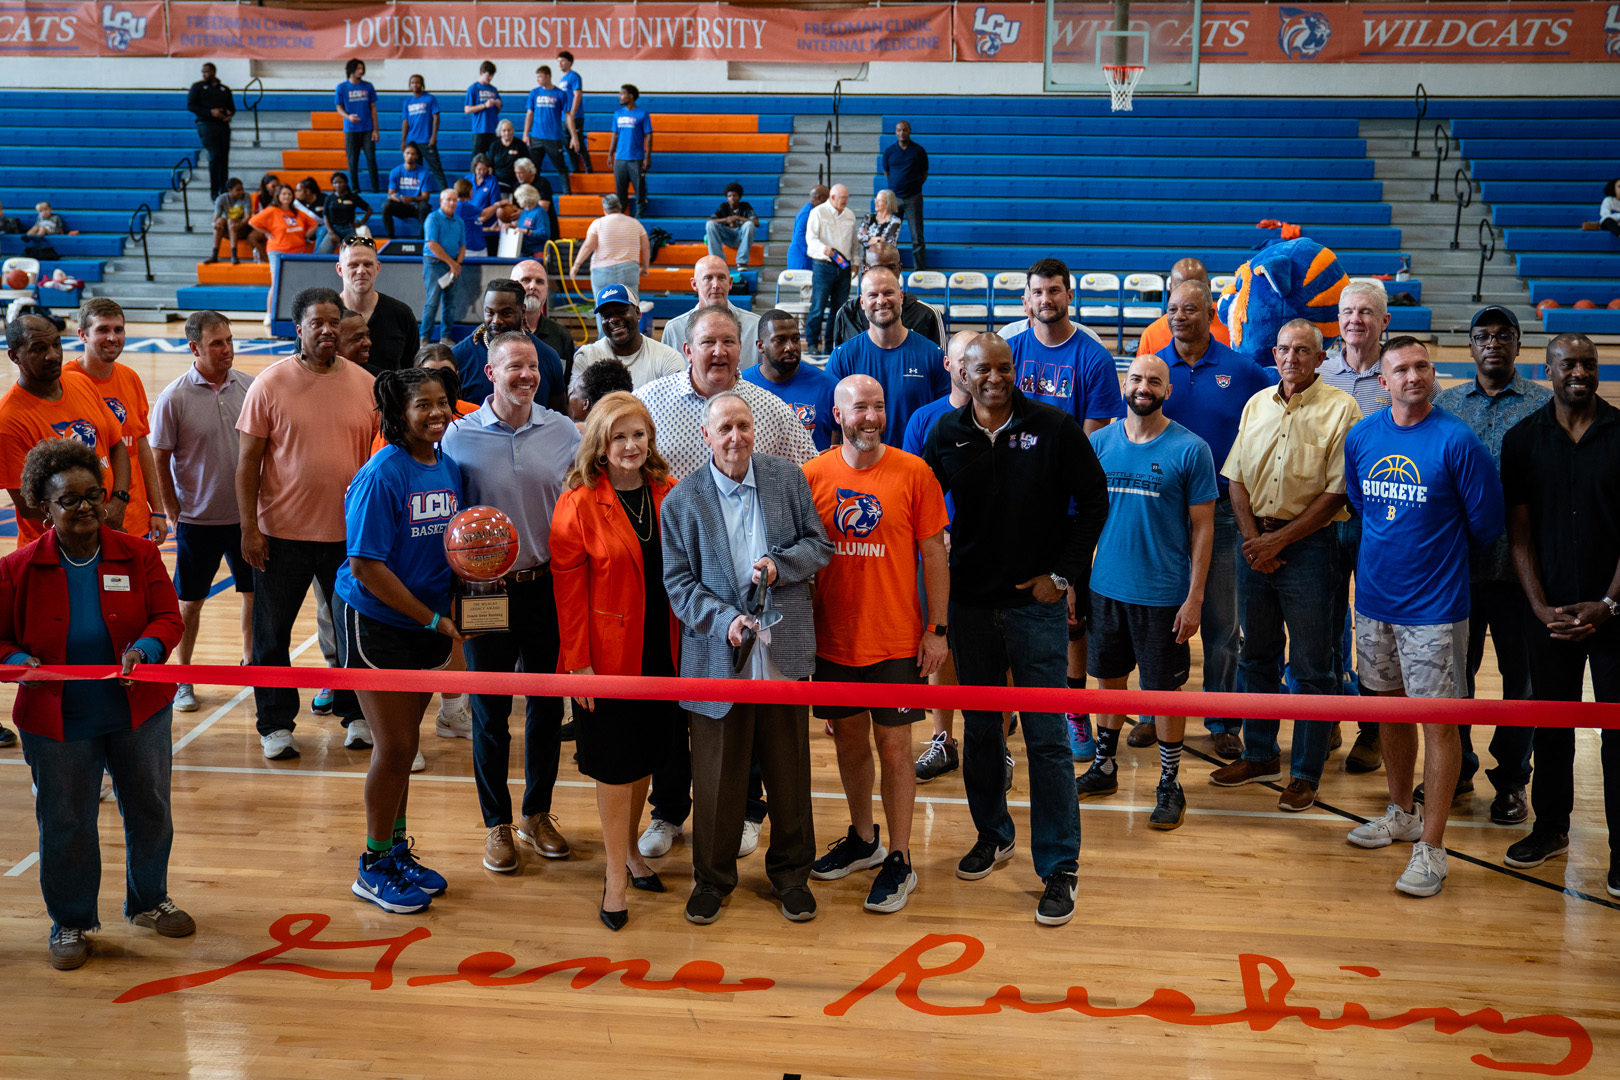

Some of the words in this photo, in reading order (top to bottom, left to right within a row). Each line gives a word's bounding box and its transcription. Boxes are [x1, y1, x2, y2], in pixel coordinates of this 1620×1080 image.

[102, 4, 147, 39] LCU
[186, 16, 260, 30] FREEDMAN
[263, 18, 308, 31] CLINIC
[804, 20, 882, 35] FREEDMAN
[886, 17, 932, 33] CLINIC
[973, 6, 1021, 44] LCU
[180, 33, 245, 48] INTERNAL
[248, 35, 315, 49] MEDICINE
[344, 16, 472, 48] LOUISIANA
[477, 16, 611, 48] CHRISTIAN
[618, 17, 767, 49] UNIVERSITY
[1361, 18, 1572, 47] WILDCATS
[797, 38, 867, 52] INTERNAL
[870, 35, 940, 51] MEDICINE
[1020, 432, 1038, 446] LCU
[1362, 479, 1427, 503] BUCKEYE
[408, 490, 451, 523] LCU
[1386, 505, 1396, 521] B
[462, 527, 511, 545] SPALDING
